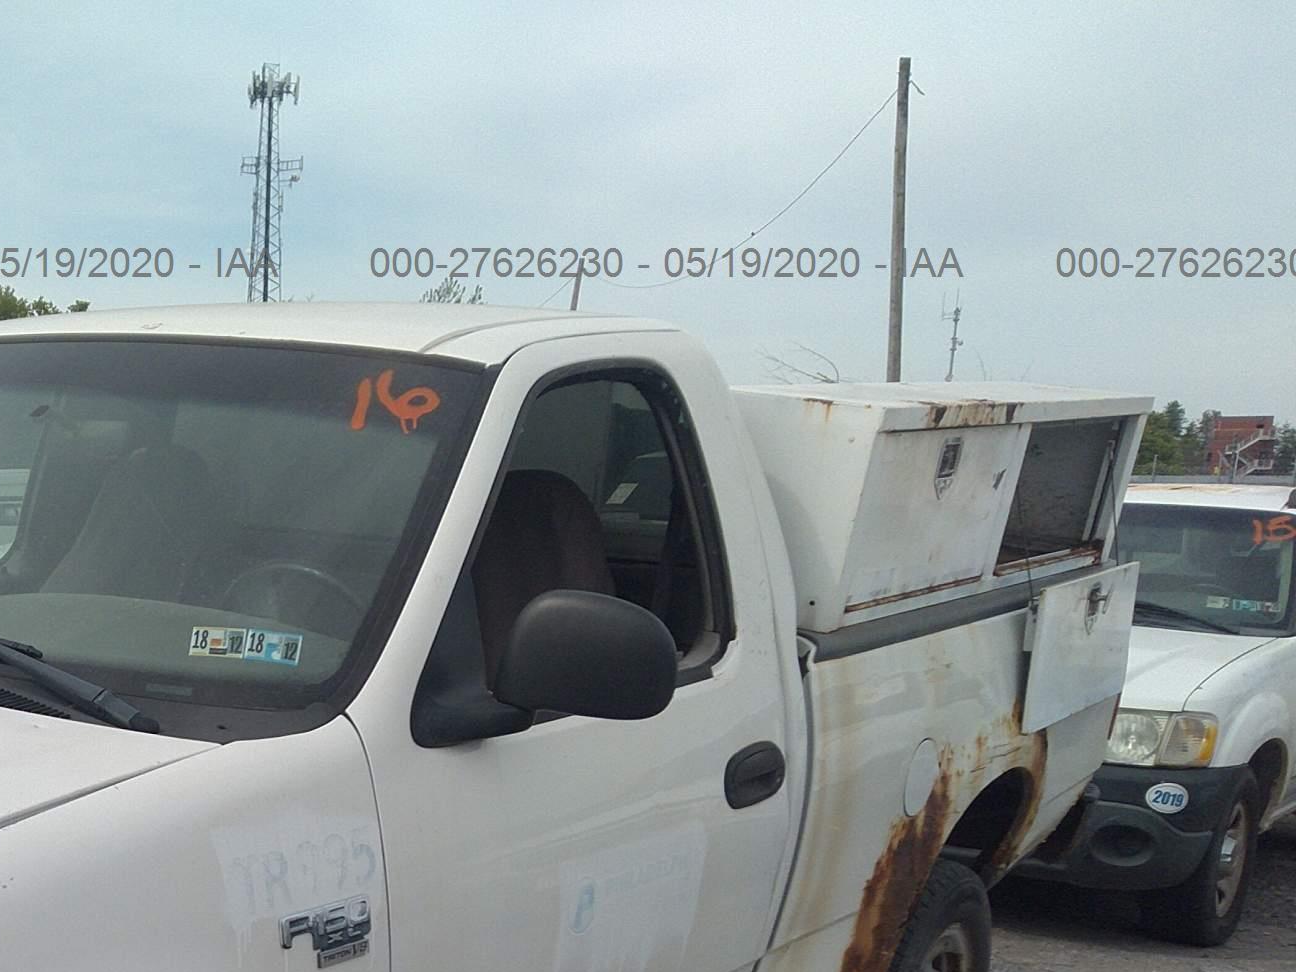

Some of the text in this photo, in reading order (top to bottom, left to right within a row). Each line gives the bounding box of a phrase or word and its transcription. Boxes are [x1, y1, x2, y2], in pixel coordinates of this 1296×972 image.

[351, 369, 440, 434] 16
[191, 630, 208, 649] 18
[247, 632, 298, 660] 18 12
[1152, 790, 1184, 807] 2019
